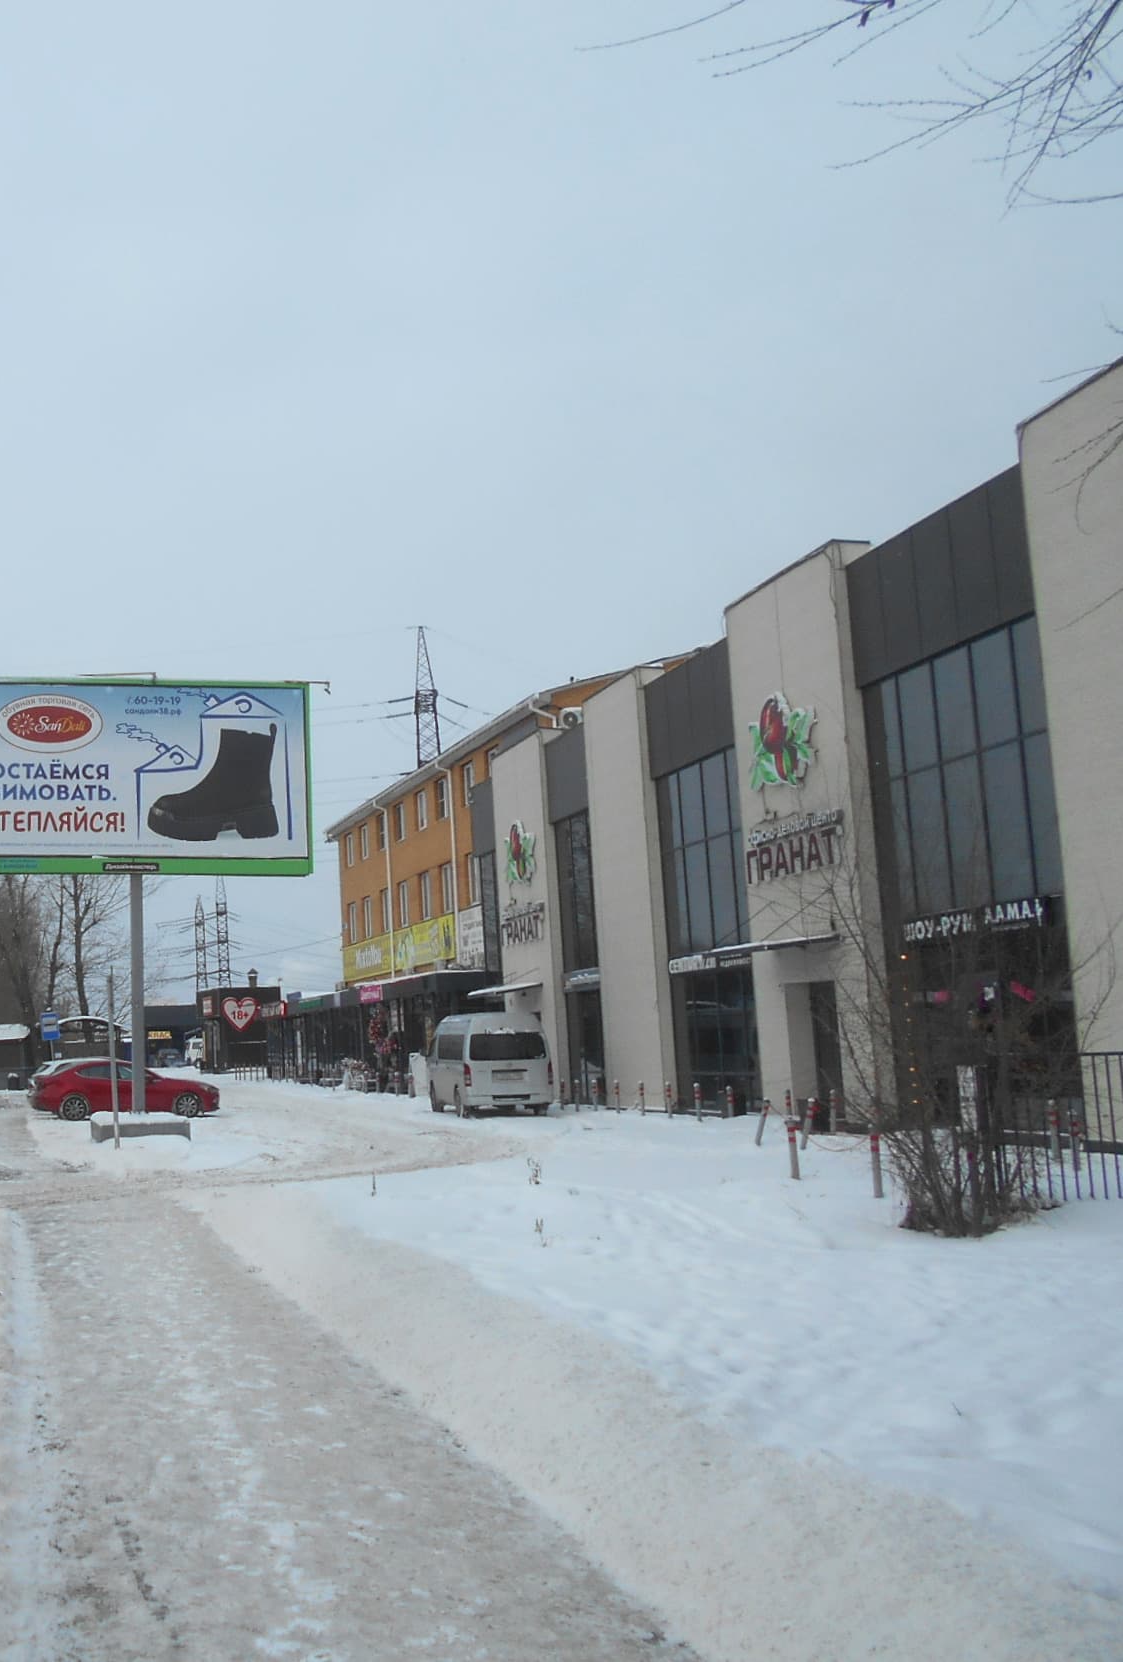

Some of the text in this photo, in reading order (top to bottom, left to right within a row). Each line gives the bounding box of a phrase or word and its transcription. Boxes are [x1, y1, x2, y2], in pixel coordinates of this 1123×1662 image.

[134, 695, 181, 705] 60-19-19
[746, 831, 835, 884] ГРАНАТ
[501, 914, 540, 946] ГРАНАТ
[232, 1010, 248, 1020] 18+
